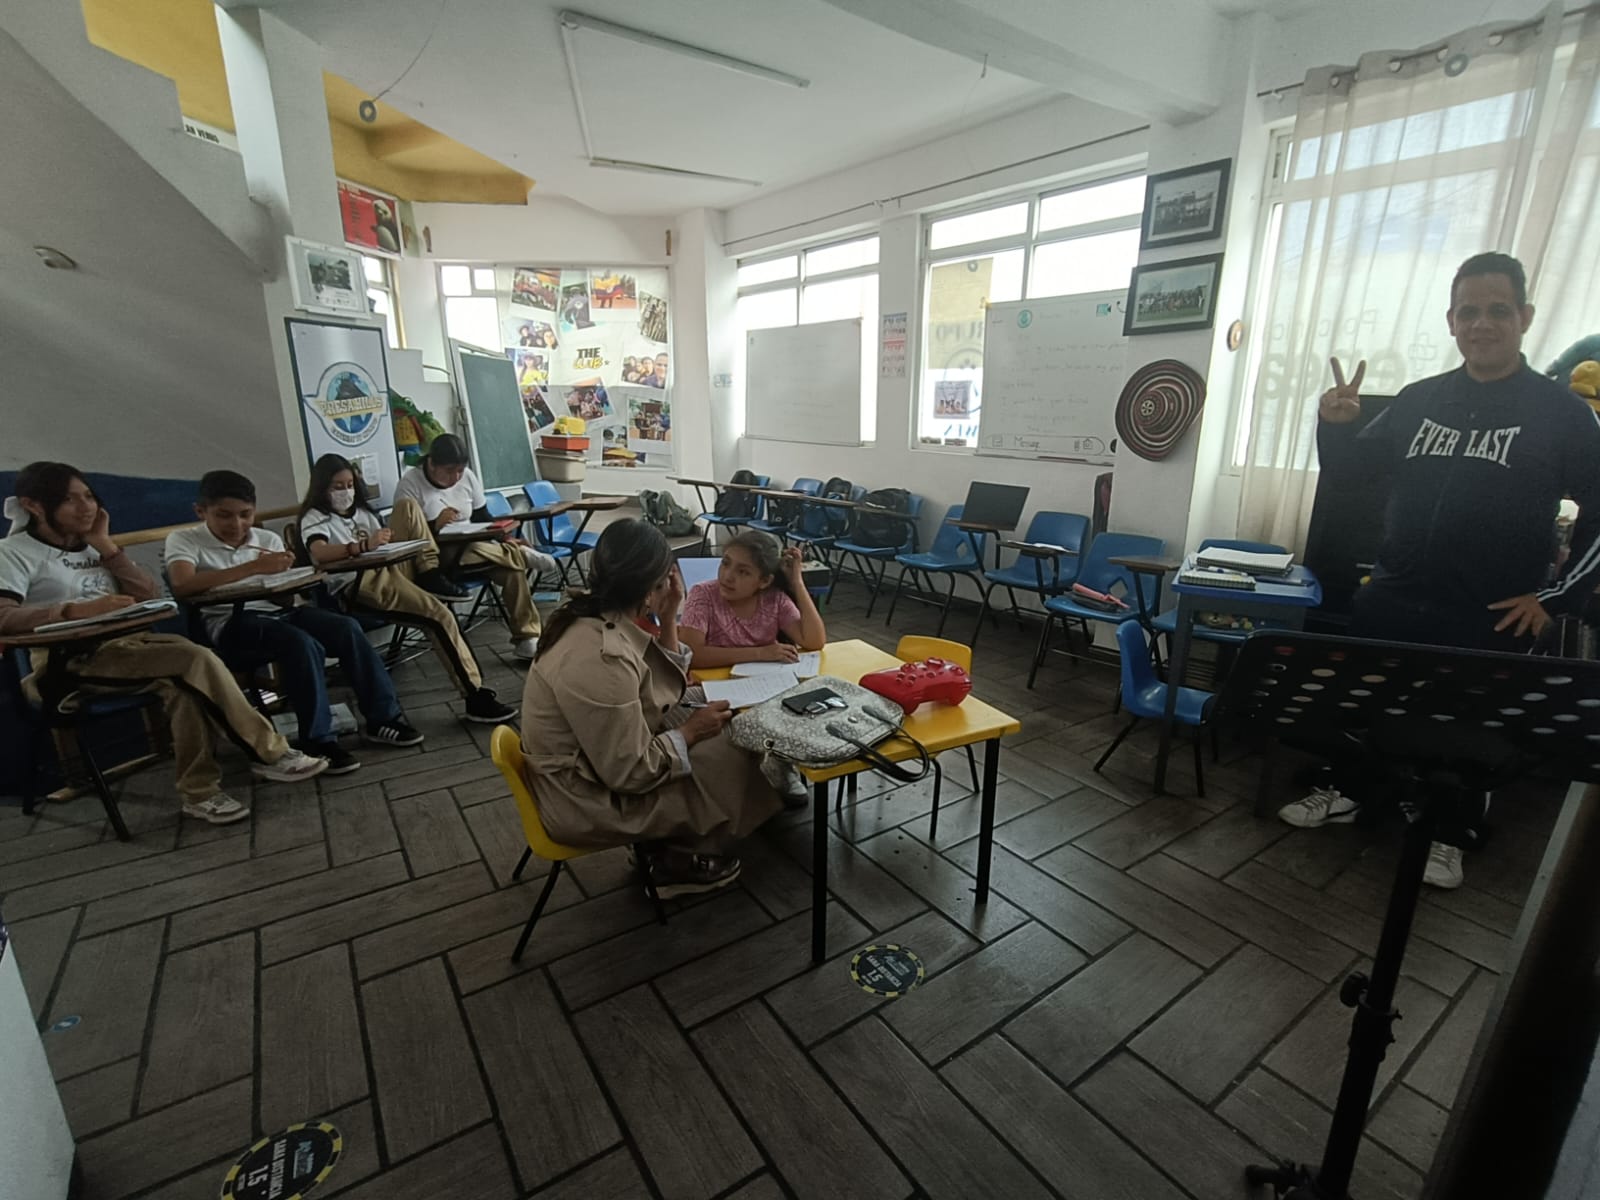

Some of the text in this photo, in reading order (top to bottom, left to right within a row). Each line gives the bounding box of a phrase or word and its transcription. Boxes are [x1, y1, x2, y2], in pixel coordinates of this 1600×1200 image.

[576, 347, 601, 359] THE
[1406, 418, 1521, 466] EVER LAST
